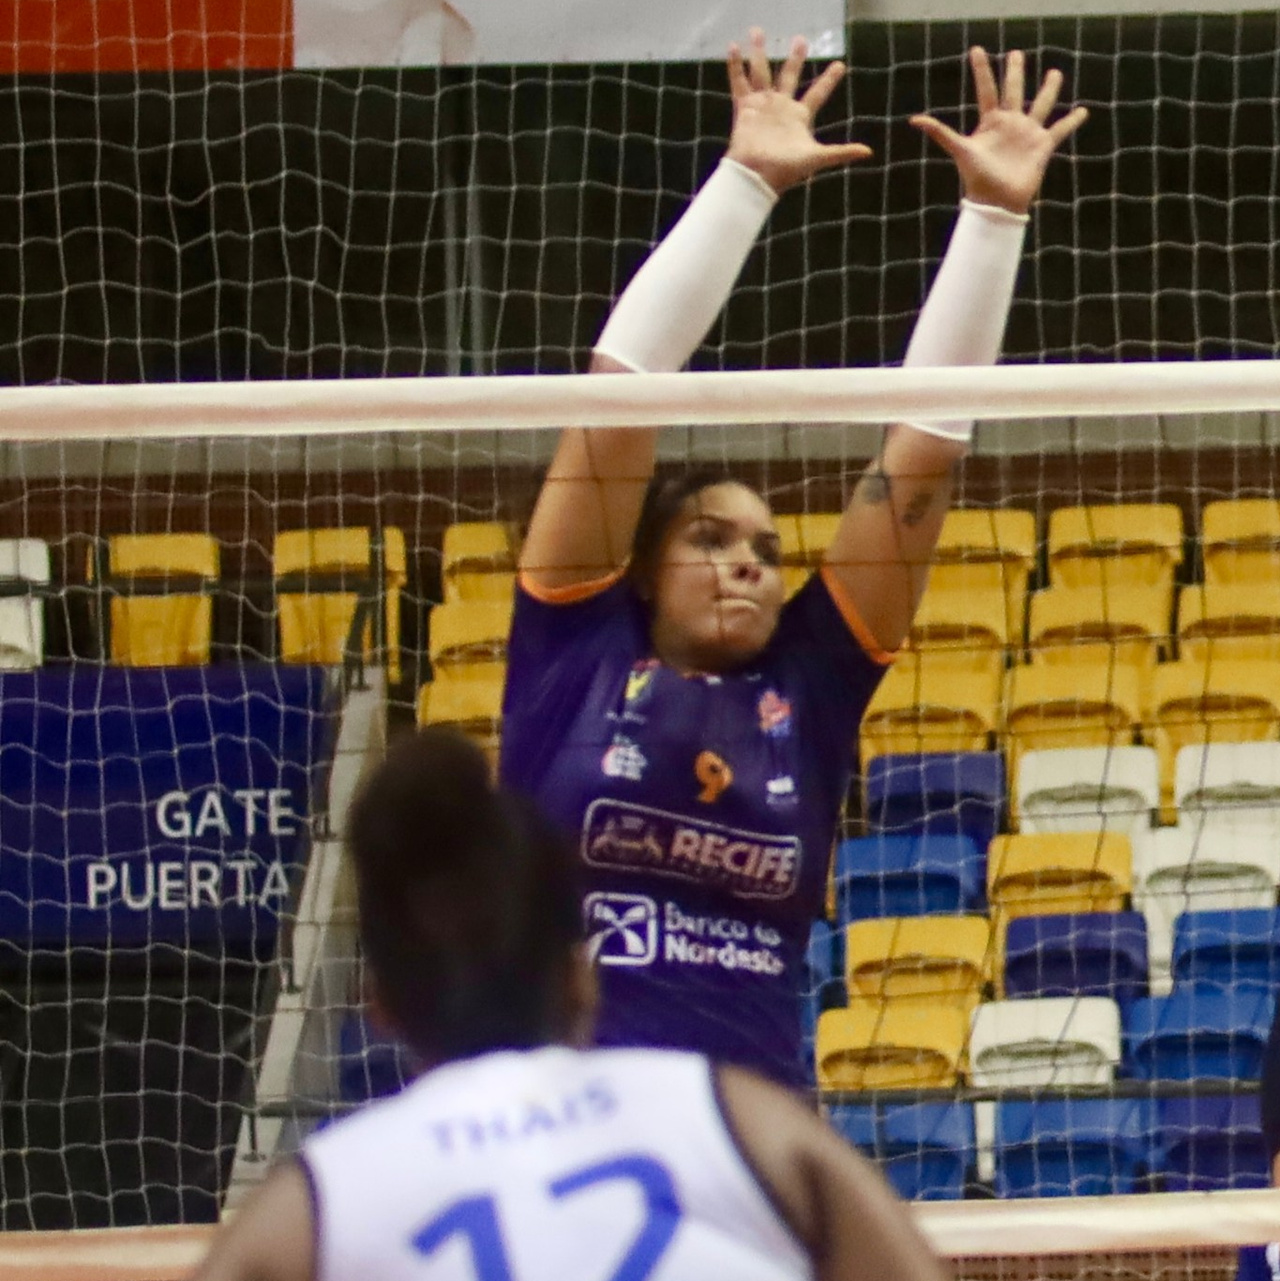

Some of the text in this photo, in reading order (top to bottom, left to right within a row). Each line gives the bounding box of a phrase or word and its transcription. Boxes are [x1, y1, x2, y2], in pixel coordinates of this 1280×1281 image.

[694, 750, 734, 803] 9
[156, 788, 296, 838] GATE
[670, 827, 797, 883] RECIFE
[87, 859, 290, 911] PUERTA
